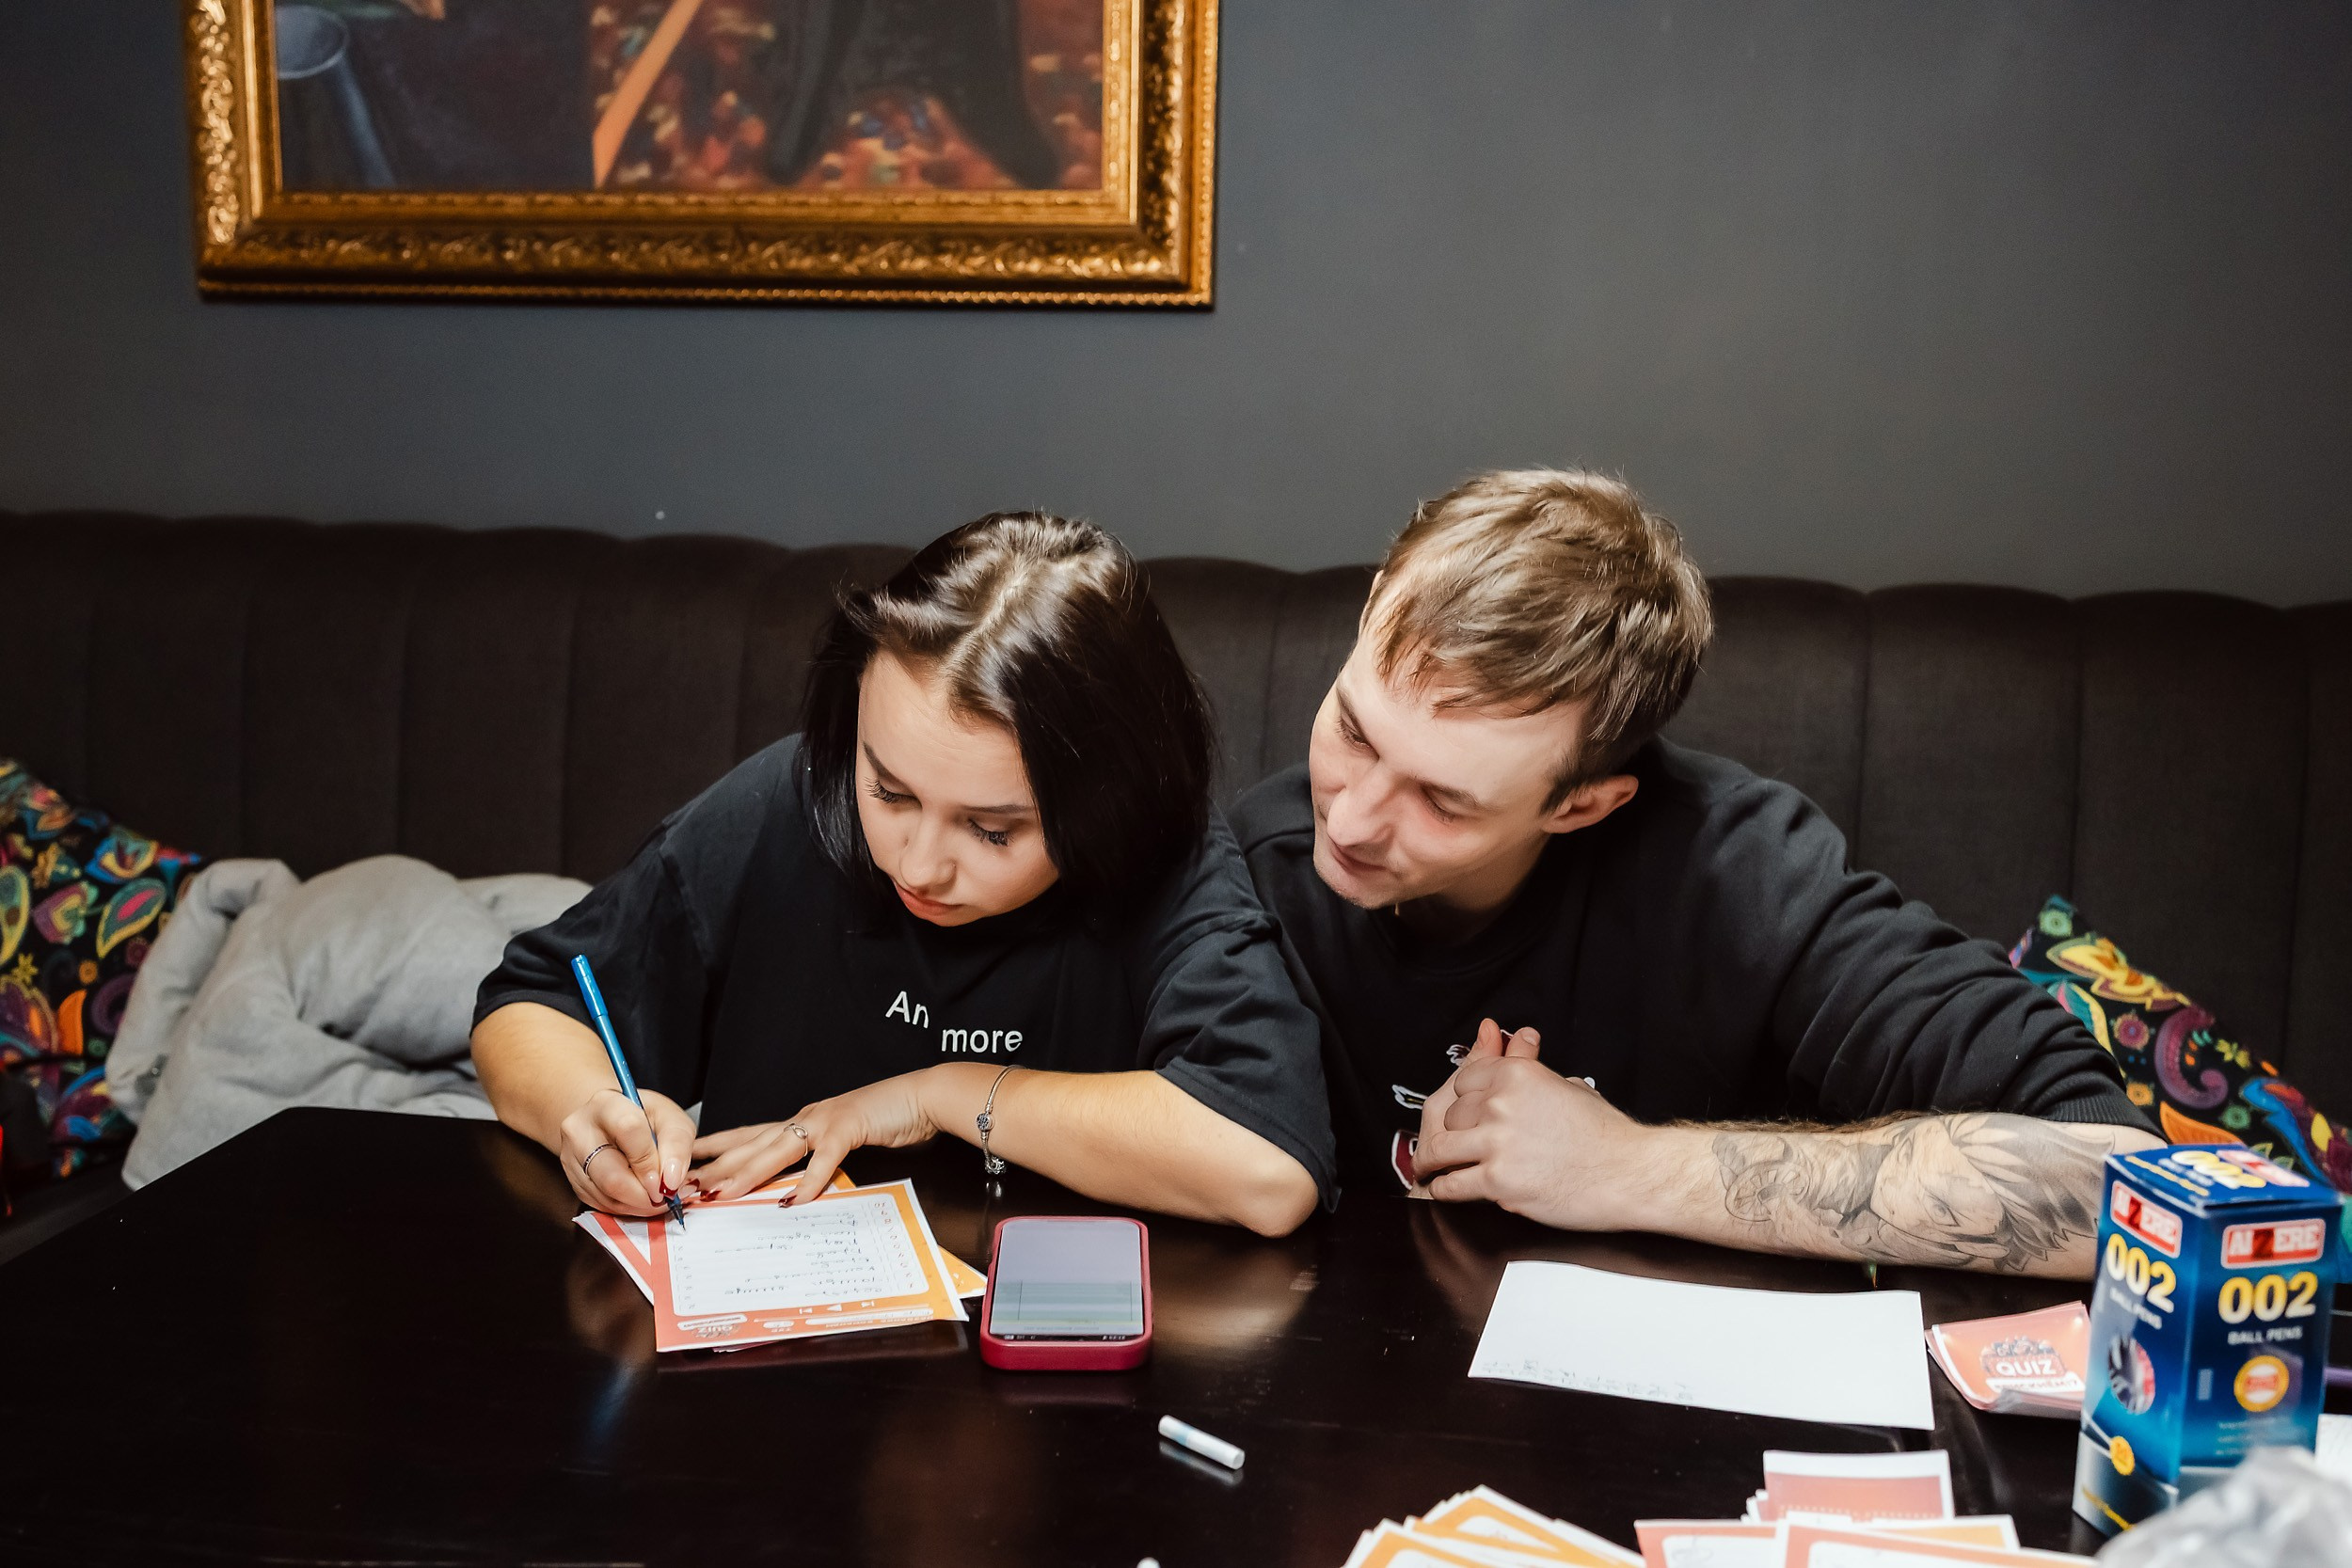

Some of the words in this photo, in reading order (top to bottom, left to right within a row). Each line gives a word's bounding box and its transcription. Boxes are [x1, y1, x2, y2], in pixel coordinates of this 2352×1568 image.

[885, 990, 930, 1029] An
[941, 1029, 1023, 1053] more
[2106, 1233, 2176, 1313] 002
[2218, 1272, 2318, 1324] 002
[2227, 1331, 2264, 1346] BALL
[2265, 1326, 2303, 1342] PENS
[1995, 1359, 2057, 1377] QUIZ
